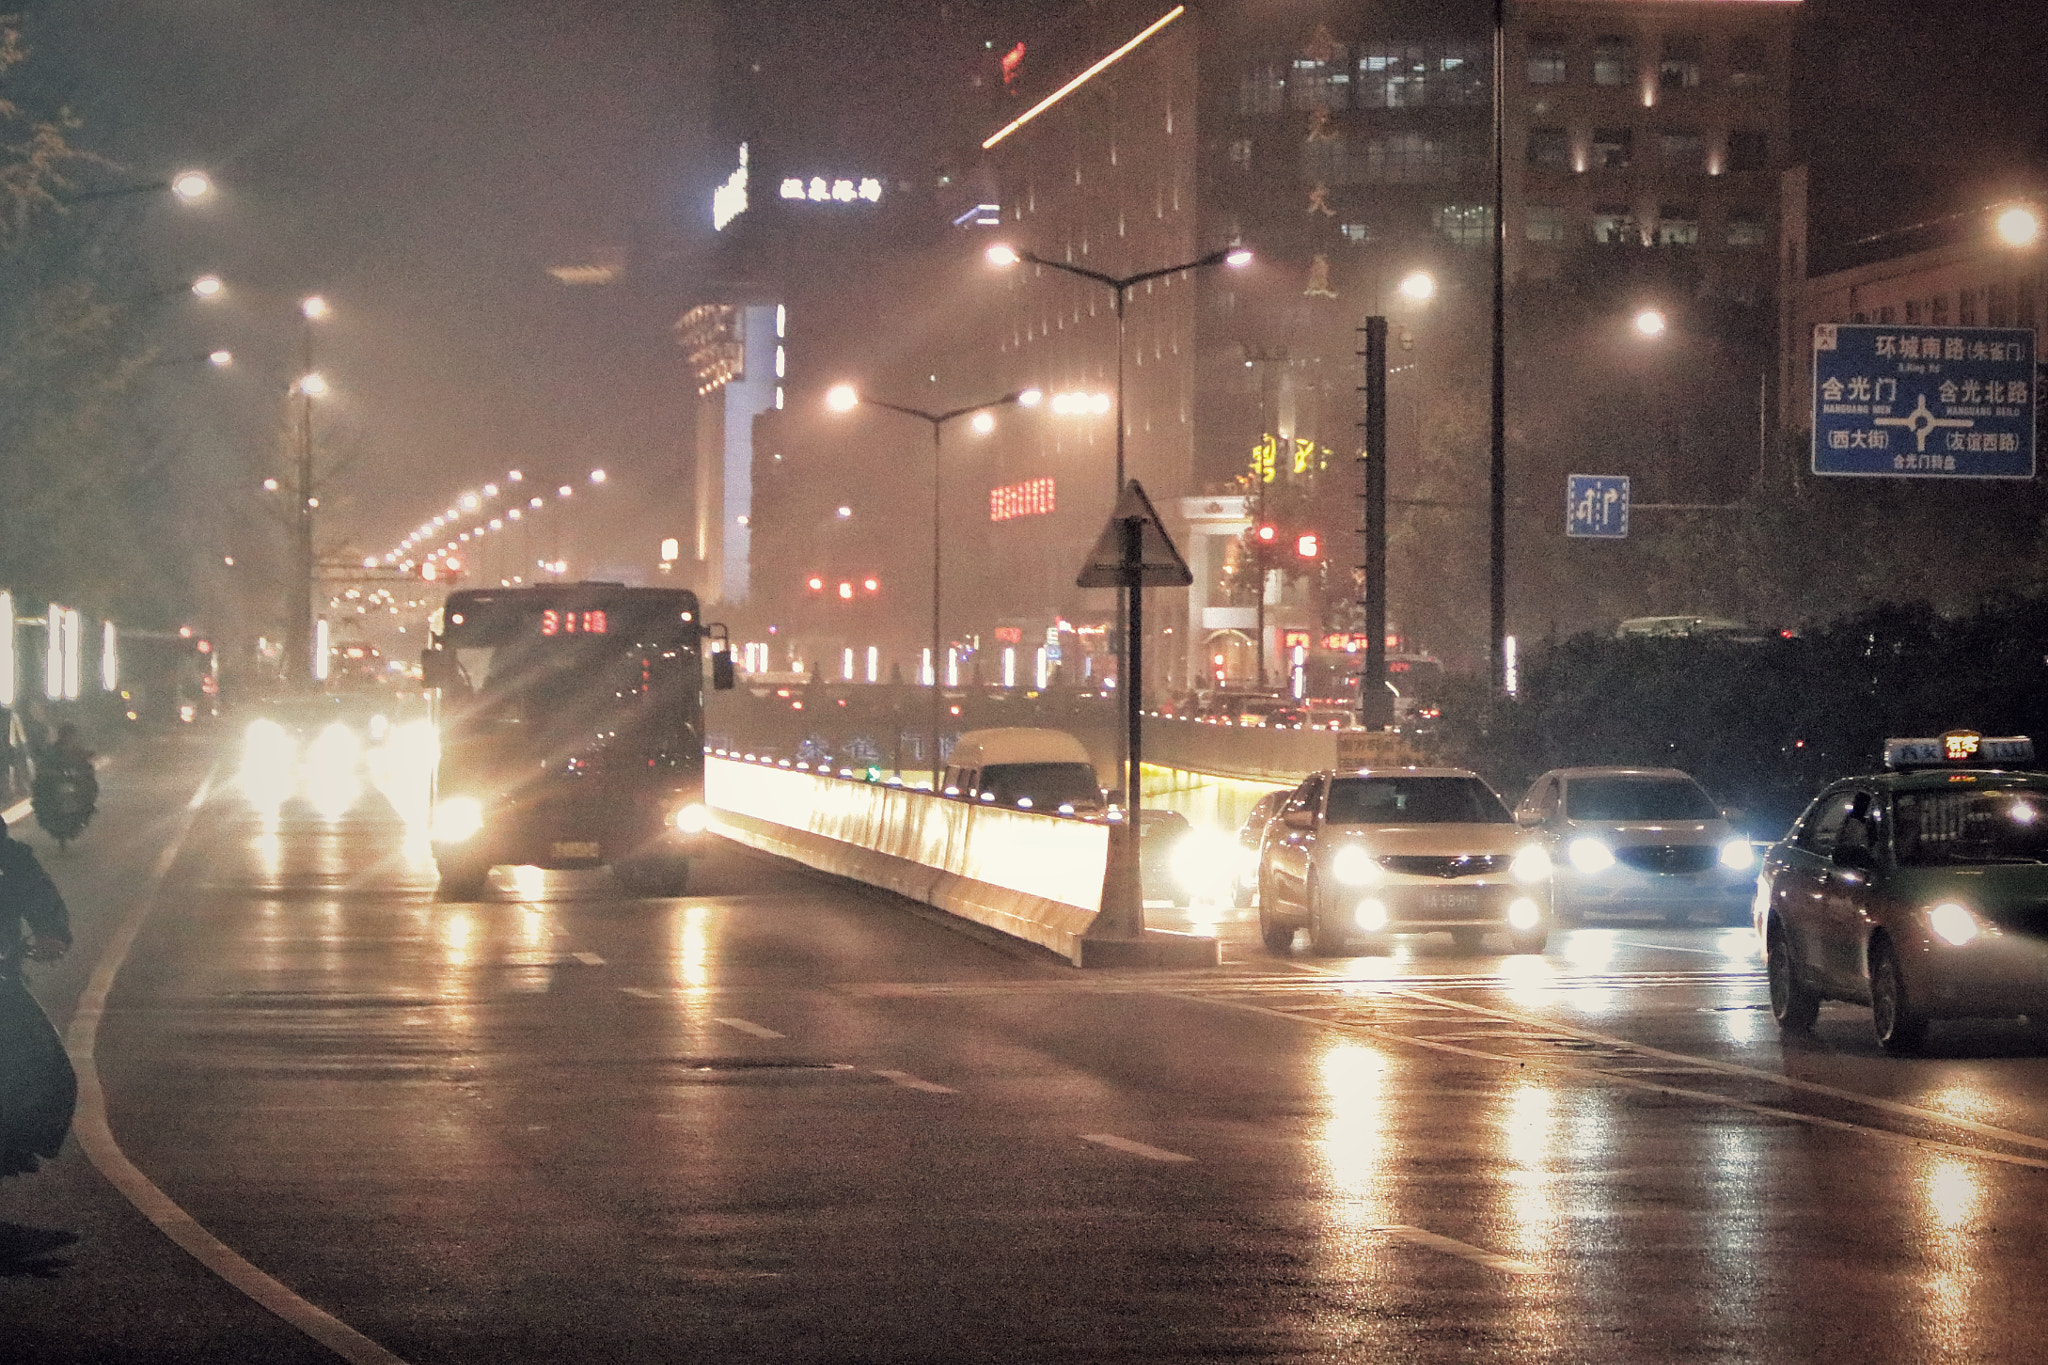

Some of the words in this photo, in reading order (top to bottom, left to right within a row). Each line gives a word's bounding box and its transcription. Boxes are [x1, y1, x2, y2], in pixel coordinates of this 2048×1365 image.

[1822, 375, 1898, 402] 含光门
[1938, 378, 2028, 404] 含光北路
[1827, 429, 1890, 450] (西大街)
[1946, 431, 2020, 452] (友谊西路)
